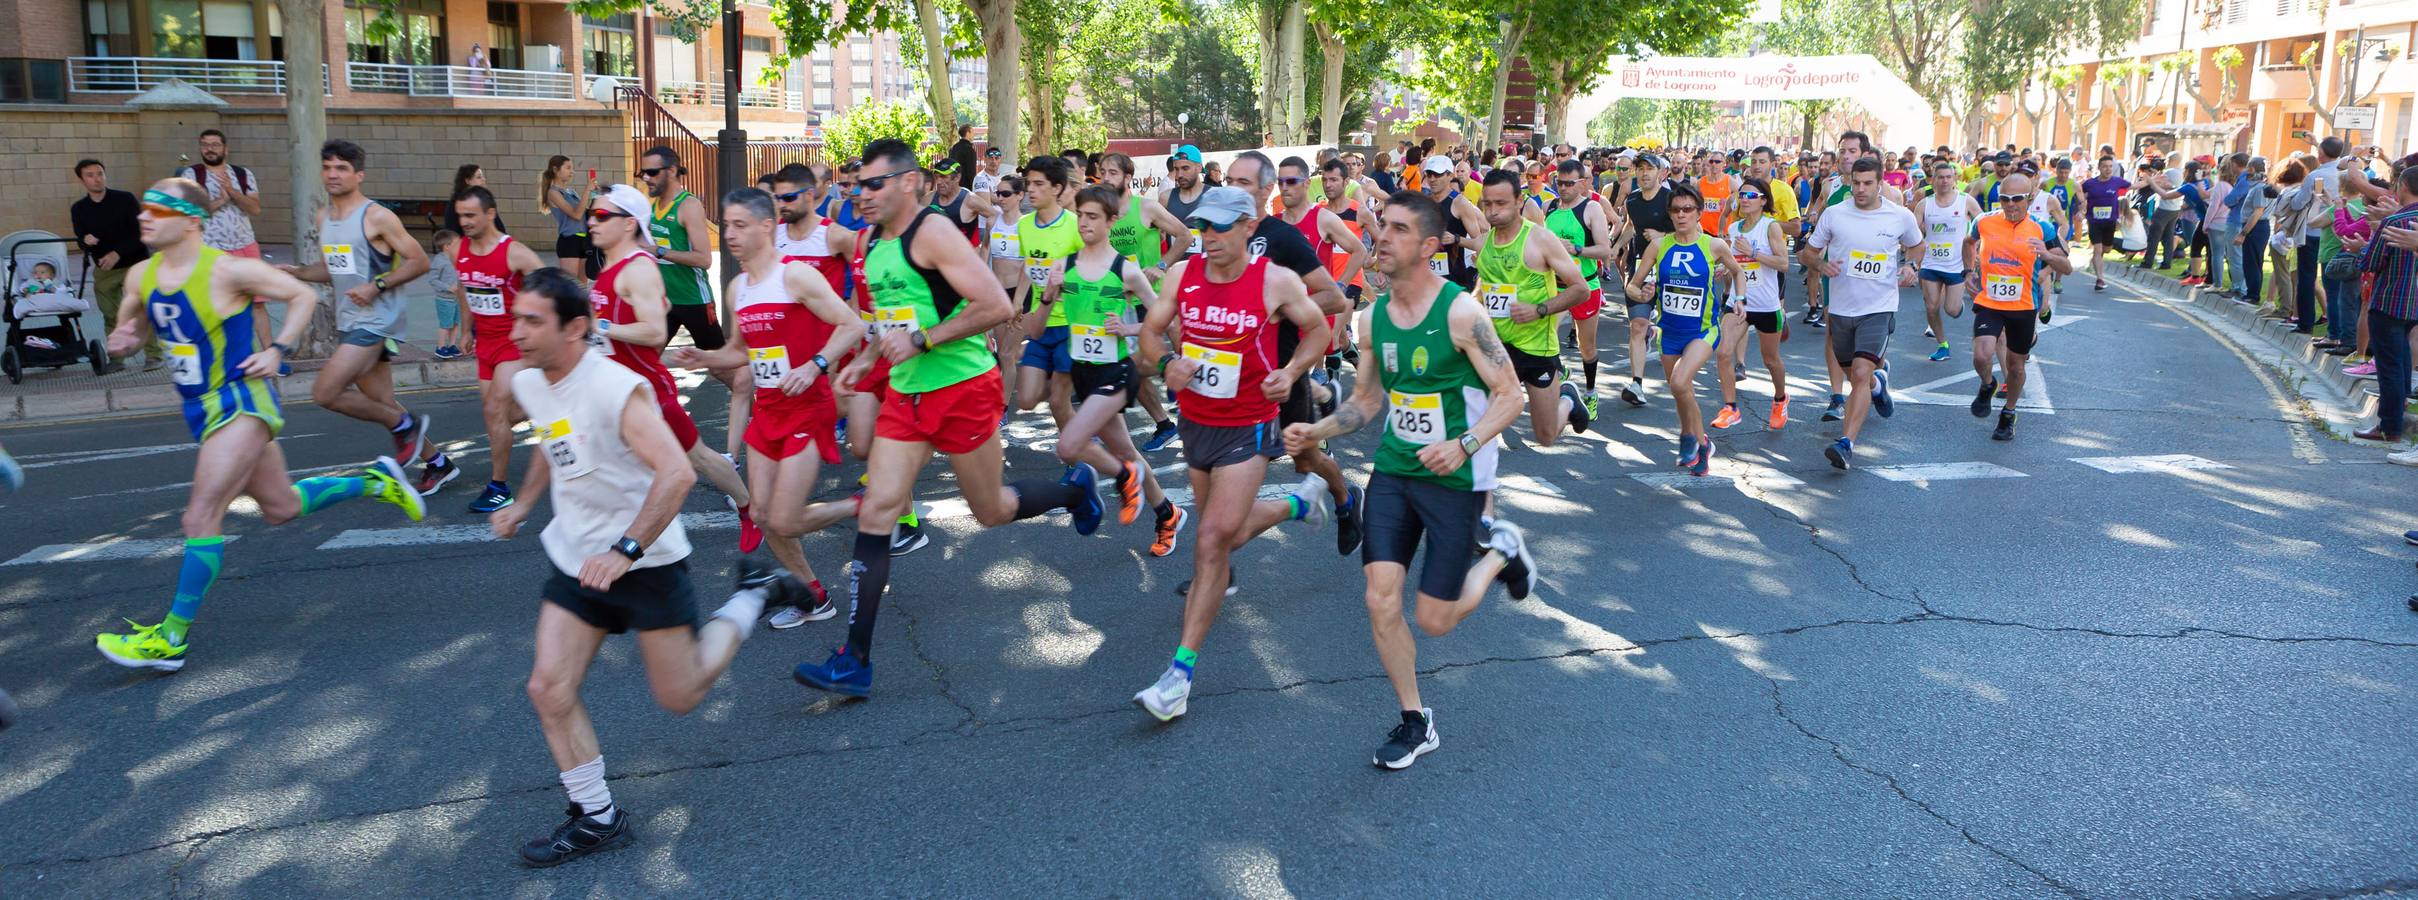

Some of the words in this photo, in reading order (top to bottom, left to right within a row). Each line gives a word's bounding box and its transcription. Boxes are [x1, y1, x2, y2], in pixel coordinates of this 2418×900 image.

[1645, 67, 1736, 79] Ayuntamiento
[1645, 80, 1660, 89] de
[1000, 240, 1008, 252] 3
[1931, 247, 1951, 258] 365
[1853, 260, 1882, 275] 400
[1991, 283, 2017, 297] 138
[1663, 293, 1701, 312] 3179
[1180, 301, 1201, 321] La
[1204, 305, 1258, 335] Rioja
[1083, 338, 1104, 355] 62
[1194, 363, 1220, 388] 46
[1395, 408, 1434, 435] 285
